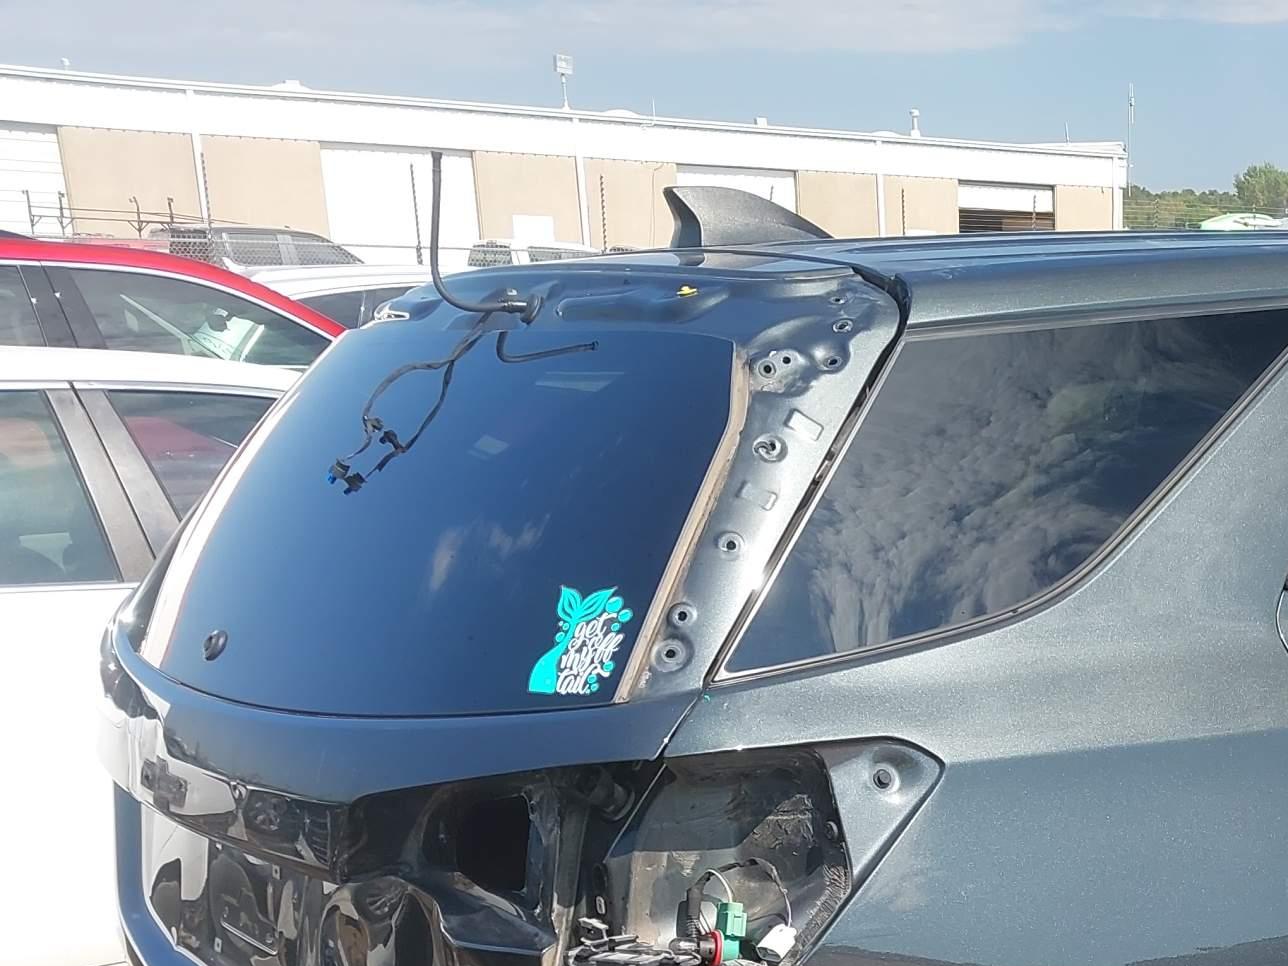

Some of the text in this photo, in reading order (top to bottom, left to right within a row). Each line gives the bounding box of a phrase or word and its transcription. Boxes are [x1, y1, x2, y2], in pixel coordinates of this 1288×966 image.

[569, 612, 618, 648] get
[560, 648, 594, 676] my
[588, 633, 625, 663] off
